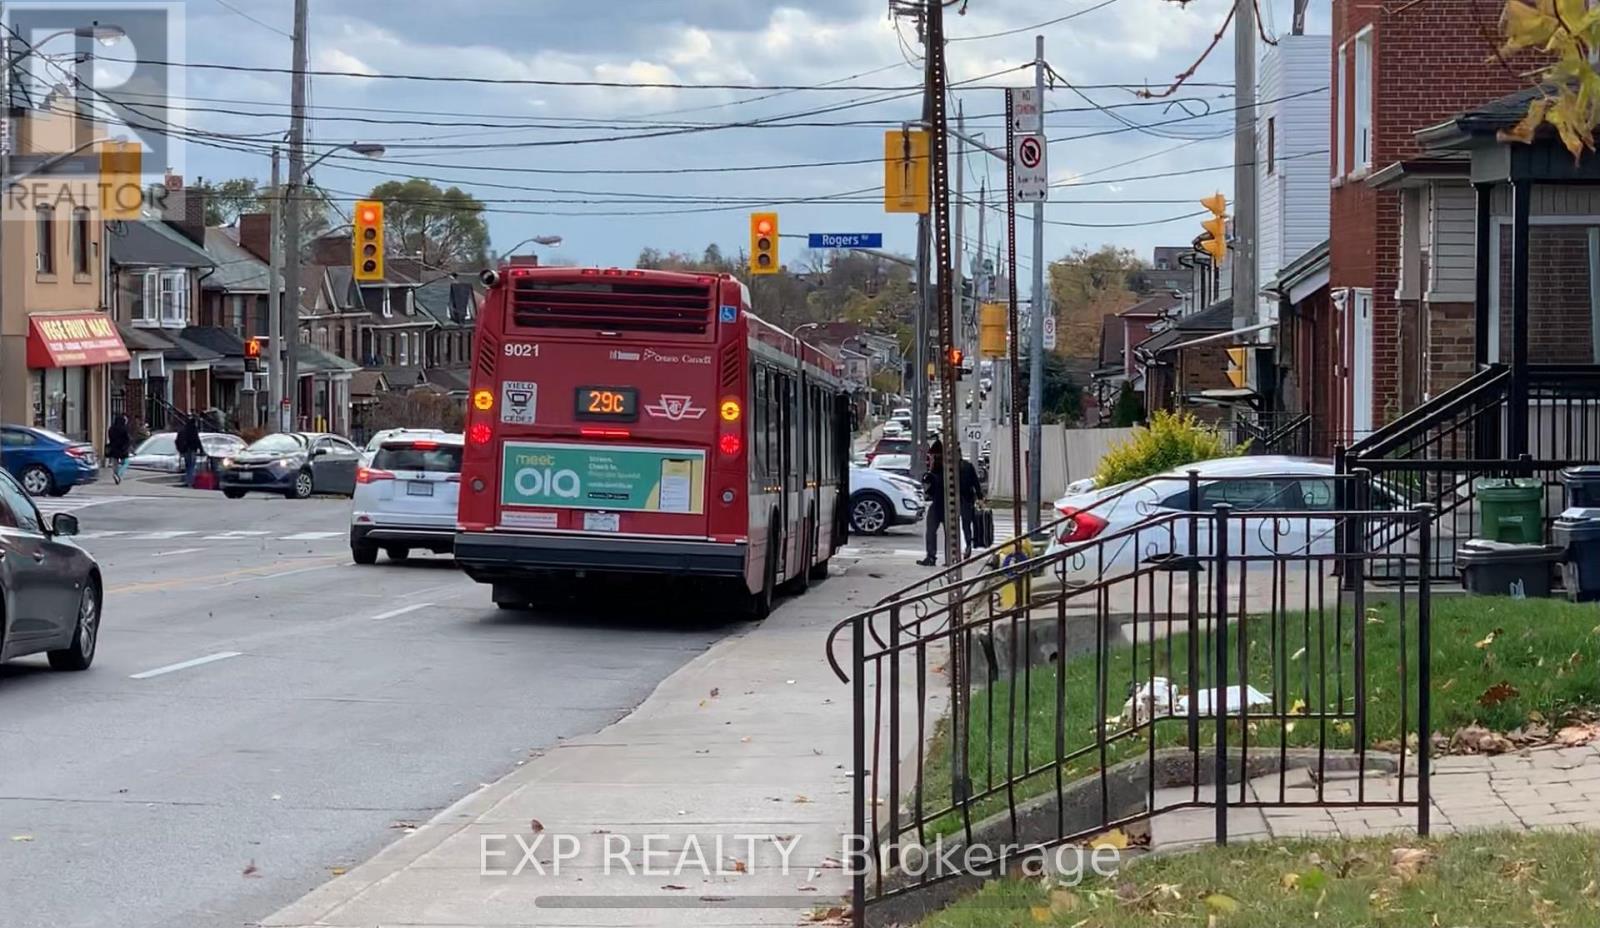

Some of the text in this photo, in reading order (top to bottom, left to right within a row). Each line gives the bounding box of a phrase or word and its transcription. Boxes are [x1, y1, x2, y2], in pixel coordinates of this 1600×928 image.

[822, 234, 859, 248] Rogers
[504, 343, 539, 357] 9021
[588, 390, 624, 413] 29C
[968, 430, 981, 440] 40
[515, 453, 556, 466] meet
